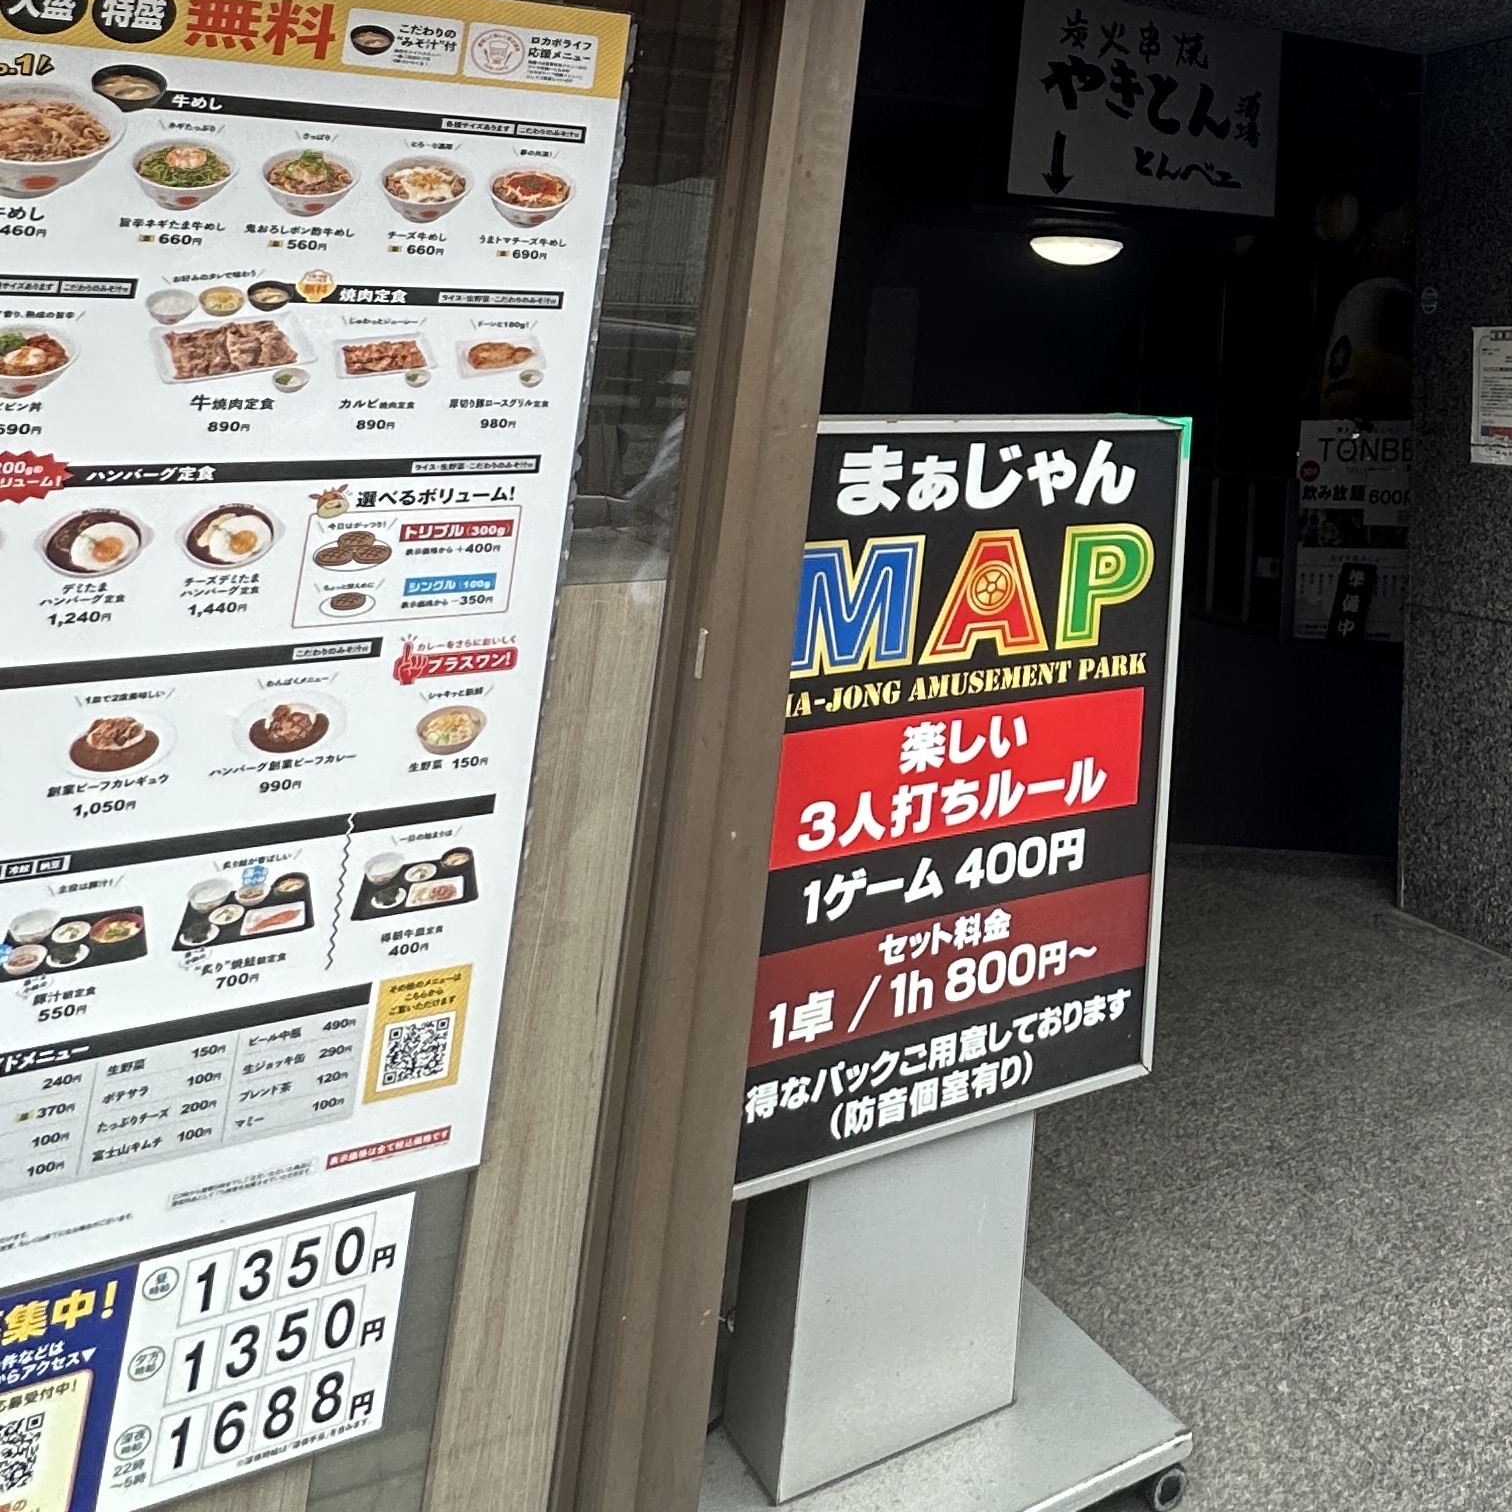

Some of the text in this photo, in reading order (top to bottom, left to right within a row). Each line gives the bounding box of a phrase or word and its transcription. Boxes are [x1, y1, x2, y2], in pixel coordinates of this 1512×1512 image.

[398, 23, 457, 40] こだわりの
[1060, 8, 1209, 69] 炭火串焼
[530, 36, 593, 51] ロカボライフ
[172, 93, 223, 112] 牛めし
[1040, 55, 1231, 139] やきとん
[158, 233, 203, 247] 660円
[286, 238, 328, 252] 560円
[387, 230, 448, 243] チーズ牛めし
[406, 244, 445, 257] 660円
[511, 249, 548, 261] 690円
[338, 288, 409, 305] 焼肉定食
[190, 393, 276, 412] 牛焼肉定食
[207, 420, 251, 434] 890円
[355, 418, 396, 431] 890円
[479, 417, 517, 430] 980円
[85, 464, 217, 483] ハンバーグ定食
[835, 439, 1137, 517] まぁじゃん
[355, 485, 516, 508] 選べるボリューム!
[187, 602, 248, 618] 1,440円
[788, 523, 1155, 679] MAP
[47, 611, 112, 627] 1,240円
[427, 651, 512, 673] プラスワン!
[908, 659, 1074, 702] AMUSEMENT
[1078, 651, 1147, 682] PARK
[899, 714, 1028, 776] 楽しい
[452, 756, 489, 769] 150円
[258, 778, 302, 795] 990円
[73, 798, 137, 819] 1,050円
[797, 756, 1108, 853] 3人打ちルール
[803, 827, 1086, 926] 1ゲーム 400円
[878, 907, 1013, 967] セット料金
[388, 941, 429, 957] 400円
[215, 972, 260, 990] 700円
[37, 1003, 88, 1023] 550円
[768, 988, 835, 1050] 1卓
[890, 970, 935, 1019] 1h
[191, 1043, 227, 1059] 150円
[41, 1073, 83, 1091] 240円
[187, 1071, 222, 1087] 100円
[312, 1096, 345, 1112] 100円
[829, 1051, 1035, 1141] (防音個室有り)
[36, 1101, 76, 1119] 370円
[179, 1098, 218, 1116] 200円
[31, 1131, 71, 1149] 100円
[177, 1126, 213, 1143] 100円
[26, 1159, 65, 1178] 100円
[196, 1225, 397, 1314] 1350円
[0, 1279, 119, 1346] 集中!
[183, 1297, 386, 1394] 1350円
[169, 1369, 375, 1471] 1688円
